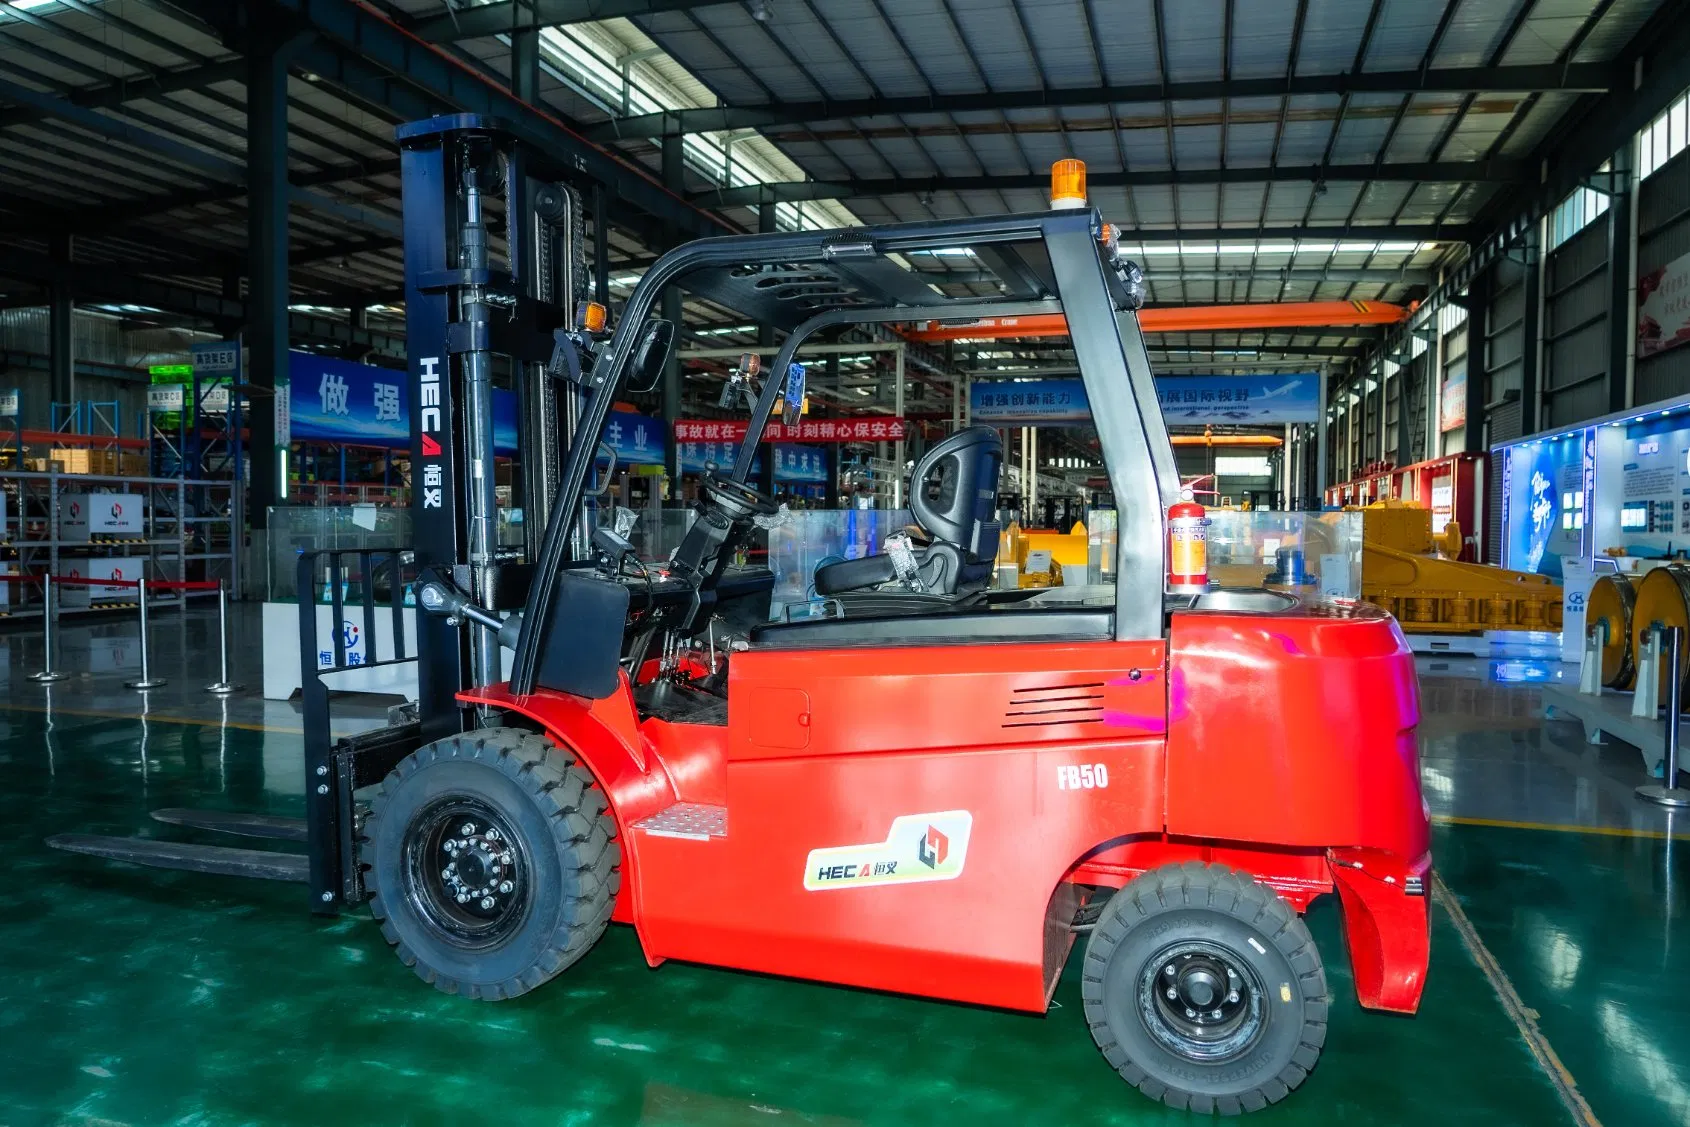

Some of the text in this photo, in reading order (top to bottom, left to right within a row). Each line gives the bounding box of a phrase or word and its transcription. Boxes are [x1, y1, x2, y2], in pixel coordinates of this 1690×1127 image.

[420, 356, 442, 457] HECA
[980, 391, 1071, 407] 增强创新能力
[609, 421, 647, 450] 主业
[675, 424, 781, 439] 事故就在一间
[1057, 763, 1108, 790] FB50
[818, 863, 871, 880] HECA
